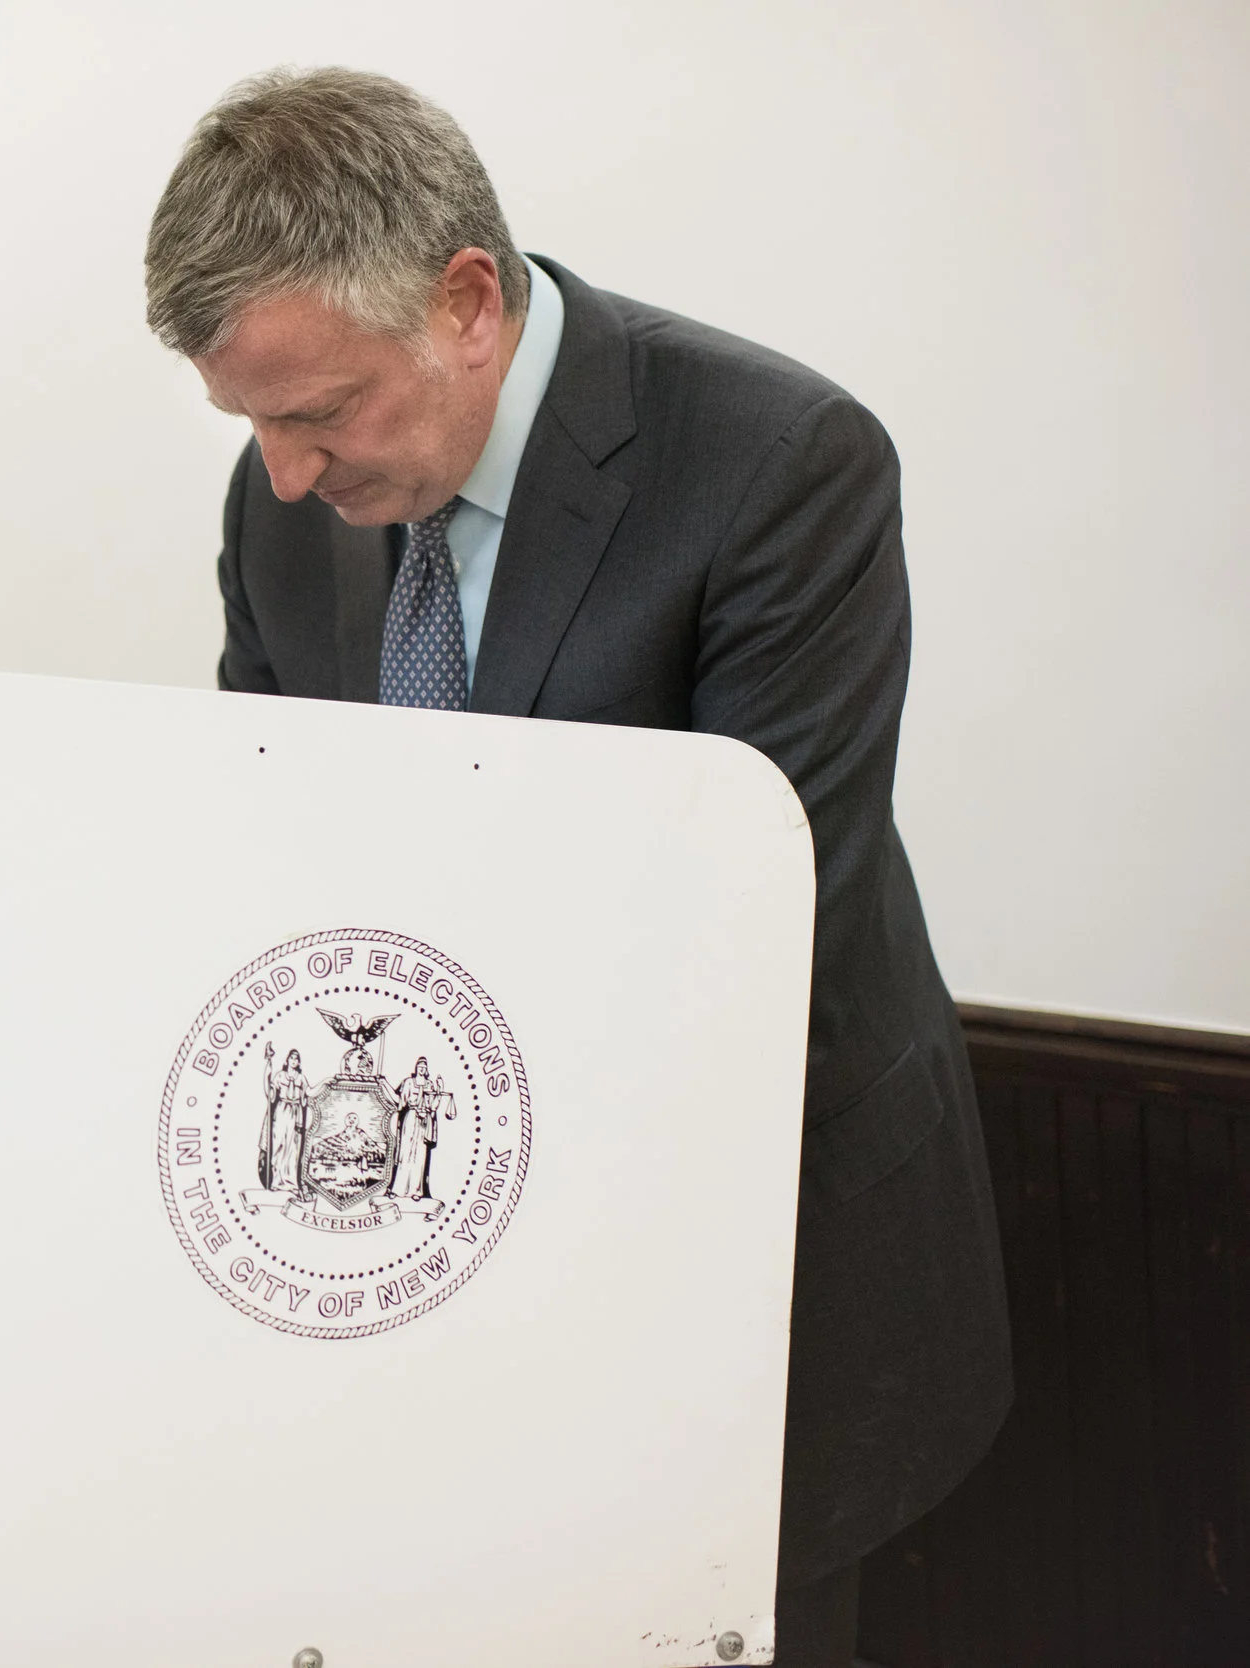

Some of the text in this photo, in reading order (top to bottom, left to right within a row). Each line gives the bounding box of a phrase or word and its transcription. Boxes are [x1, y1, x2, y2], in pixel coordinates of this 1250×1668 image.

[193, 948, 511, 1098] BOARD OF ELECTIONS
[176, 1127, 512, 1318] IN THE CITY OF NEW YORK
[301, 1212, 383, 1231] EXCELSIOR
